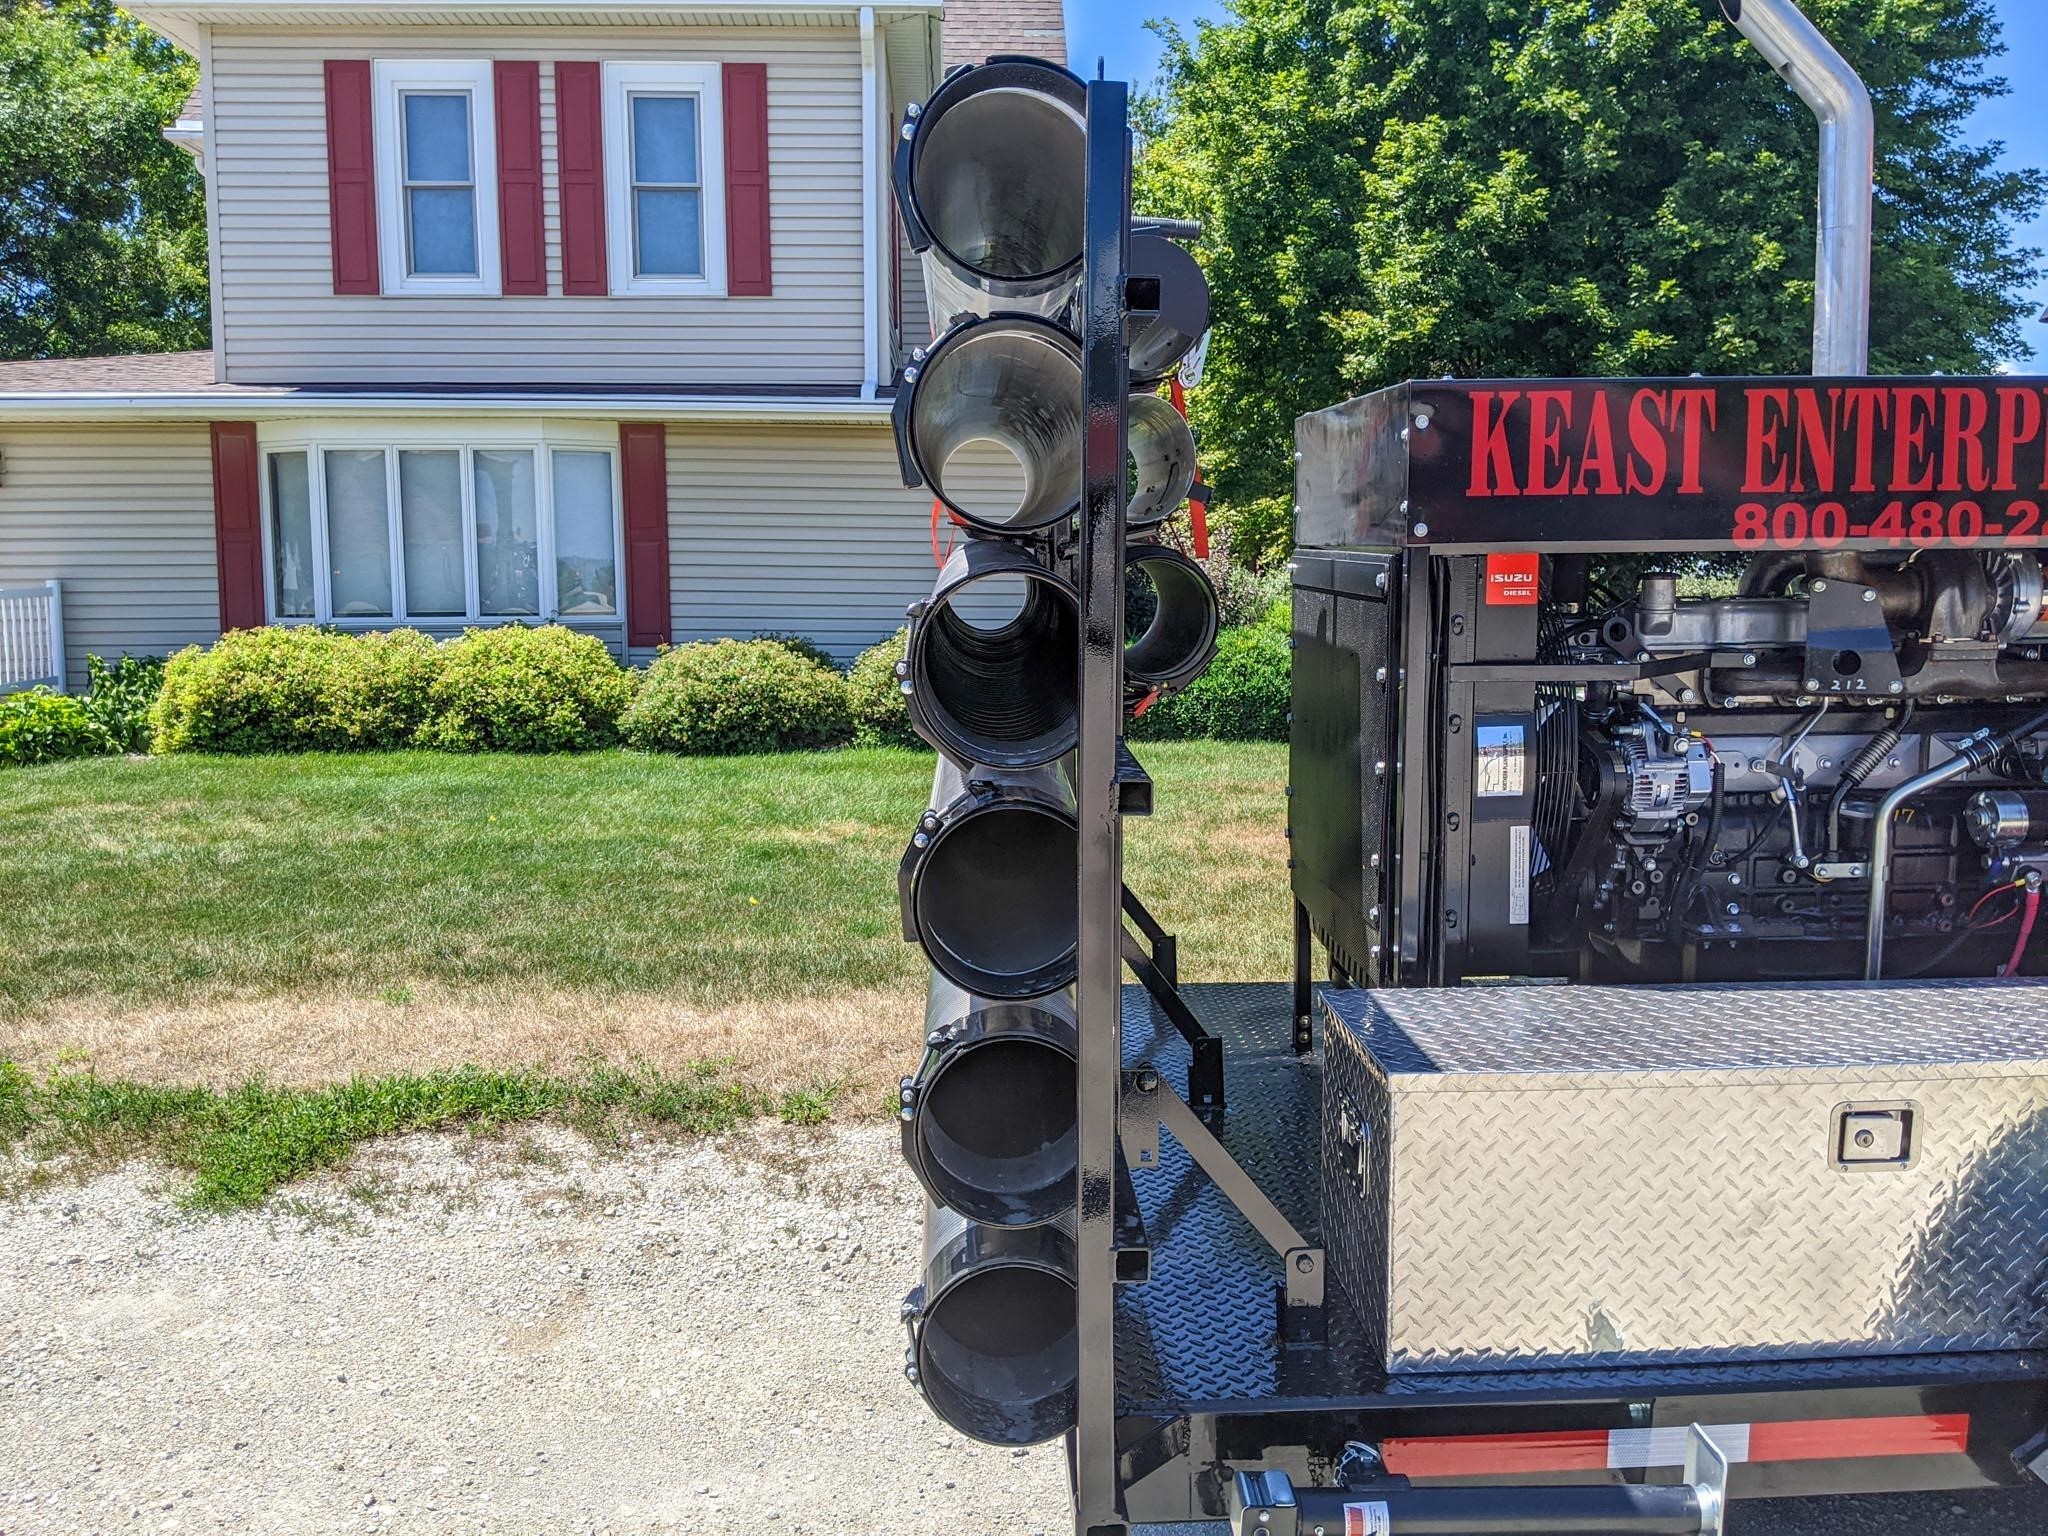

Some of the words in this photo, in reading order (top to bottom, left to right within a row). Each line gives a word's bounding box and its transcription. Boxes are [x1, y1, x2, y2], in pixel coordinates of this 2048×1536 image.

[1466, 388, 1716, 496] KEAST
[1740, 386, 2048, 493] ENTERP
[1732, 500, 2048, 549] 800-480-2
[1490, 573, 1533, 583] ISUZU
[1830, 678, 1867, 691] 212
